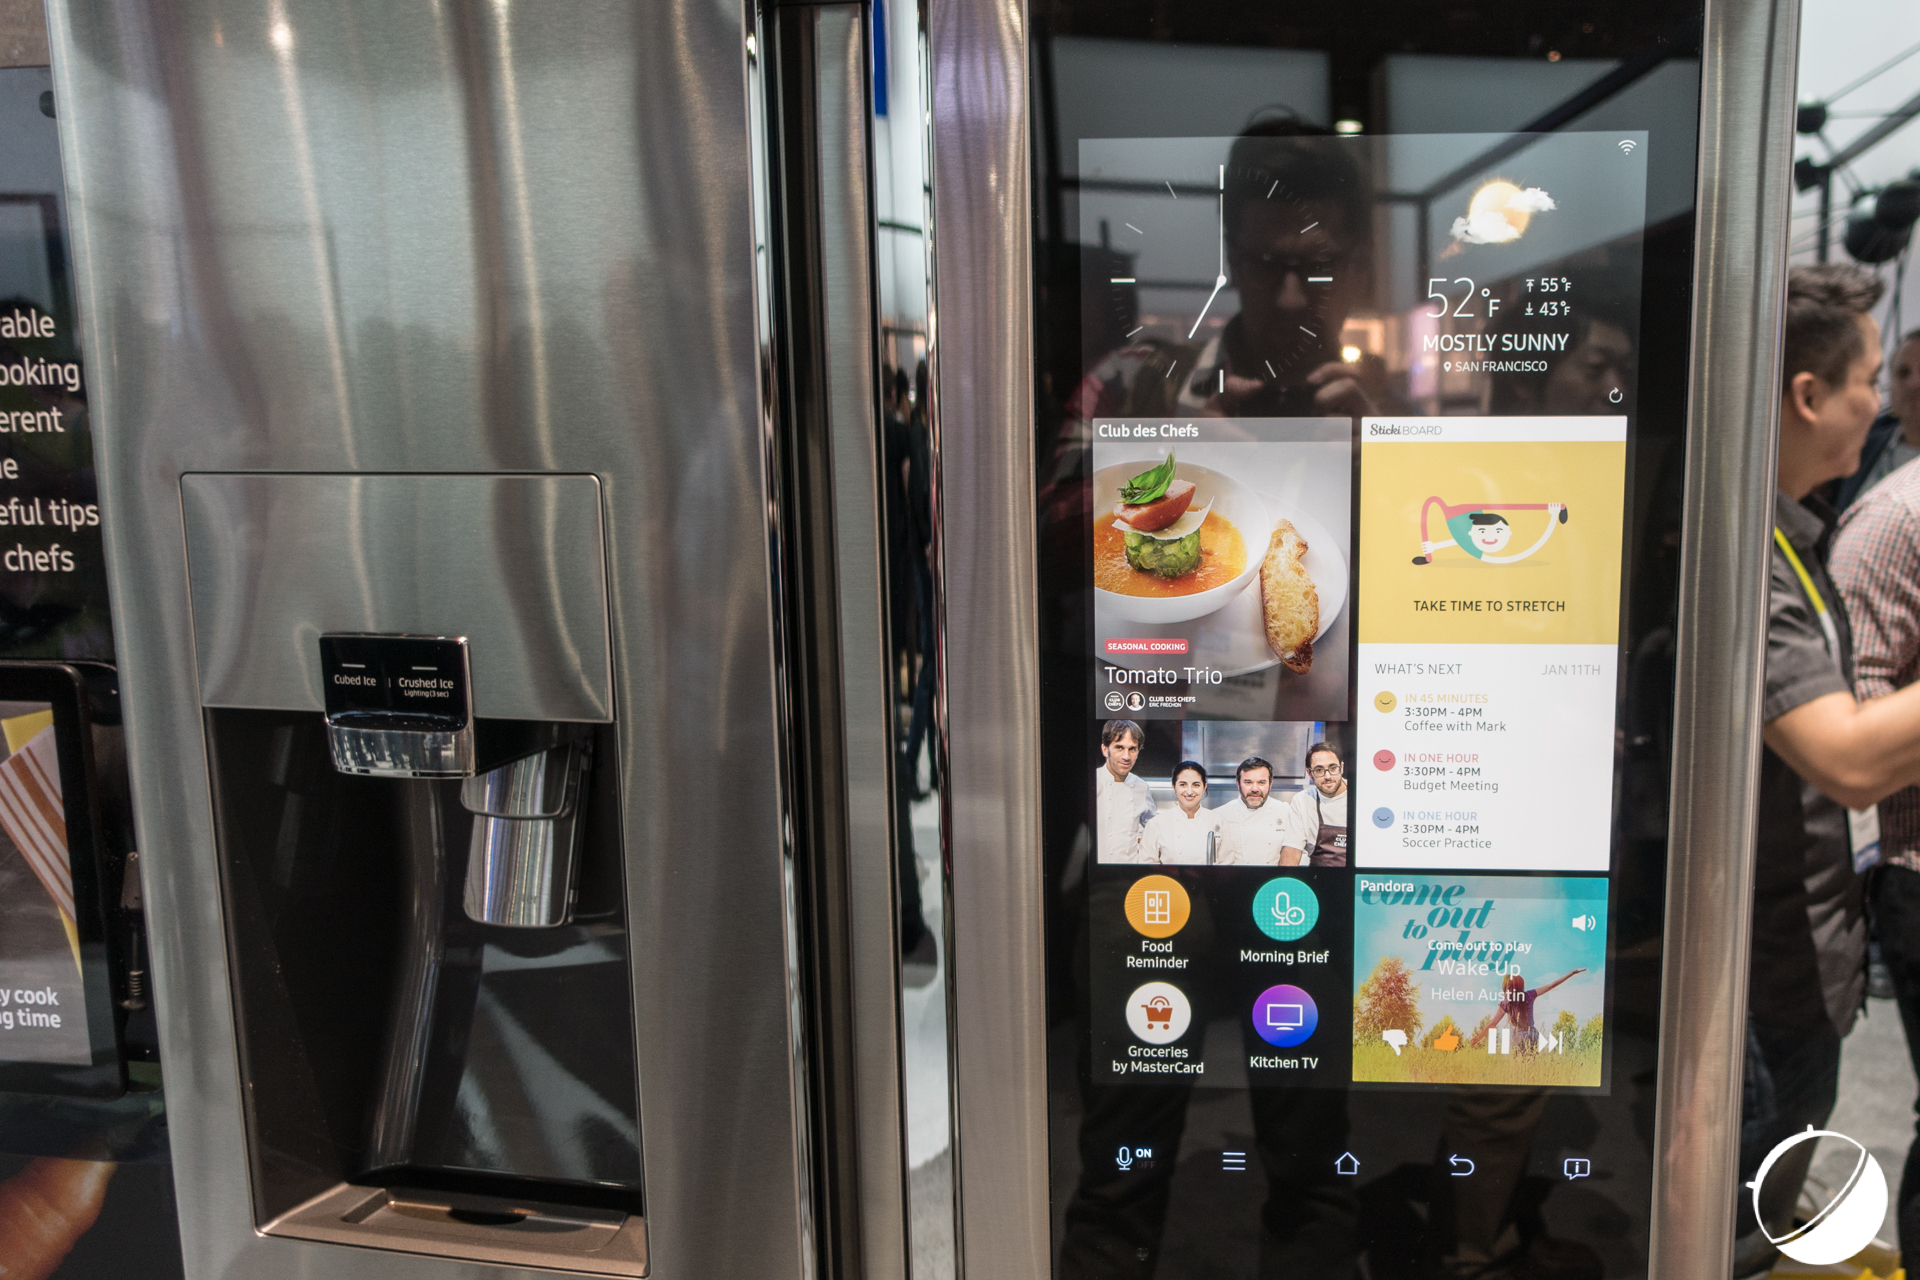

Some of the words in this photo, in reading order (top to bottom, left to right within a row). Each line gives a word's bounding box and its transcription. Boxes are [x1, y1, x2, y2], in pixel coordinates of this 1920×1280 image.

[0, 308, 55, 338] able
[1423, 334, 1497, 352] MOSTLY
[1501, 333, 1569, 351] SUNNY
[1455, 361, 1479, 372] SAN
[1482, 361, 1548, 372] FRANCISCO
[0, 356, 80, 391] ooking
[0, 406, 65, 433] erent
[1098, 424, 1130, 438] Club
[1133, 424, 1157, 438] des
[1160, 424, 1199, 437] Chefs
[0, 457, 19, 480] e
[0, 496, 45, 526] eful
[49, 498, 100, 532] tips
[4, 543, 75, 572] chefs
[1413, 600, 1447, 612] TAKE
[1450, 600, 1482, 612] TIME
[1486, 600, 1503, 612] TO
[1506, 600, 1565, 612] STRETCH
[1107, 643, 1148, 651] SEASONAL
[1150, 643, 1186, 651] COOKING
[1104, 666, 1177, 685] Tomato
[1183, 666, 1223, 685] Trio
[1428, 663, 1462, 675] NEXT
[1541, 664, 1568, 676] JAN
[1571, 664, 1601, 676] 11TH
[334, 674, 361, 686] Cubed
[363, 676, 377, 686] Ice
[398, 677, 437, 689] Crushed
[439, 679, 454, 689] Ice
[1405, 694, 1417, 703] IN
[1420, 694, 1433, 703] 45
[1437, 694, 1489, 704] MINUTES
[1404, 707, 1447, 717] 3:30PM
[1458, 707, 1482, 717] 4PM
[1404, 720, 1443, 731] Coffee
[1446, 720, 1472, 731] with
[1476, 721, 1506, 732] Mark
[1404, 753, 1416, 763] IN
[1419, 753, 1443, 763] ONE
[1446, 753, 1479, 763] HOUR
[1403, 766, 1446, 776] 3:30PM
[1456, 767, 1481, 777] 4PM
[1403, 780, 1446, 793] Budget
[1450, 780, 1499, 793] Meeting
[1403, 811, 1415, 820] IN
[1418, 811, 1442, 821] ONE
[1445, 811, 1478, 821] HOUR
[1402, 824, 1444, 834] 3:30PM
[1455, 824, 1479, 834] 4PM
[1402, 837, 1441, 848] Soccer
[1444, 837, 1492, 848] Practice
[1360, 880, 1414, 892] Pandora
[1427, 900, 1496, 929] out
[1402, 919, 1428, 939] to
[1141, 940, 1173, 953] Food
[1428, 940, 1463, 951] Come
[1465, 941, 1487, 951] out
[1489, 941, 1502, 951] to
[1505, 941, 1532, 954] play
[1126, 956, 1189, 969] Reminder
[1240, 950, 1294, 965] Morning
[1297, 950, 1330, 963] Brief
[1437, 959, 1489, 976] Wake
[1495, 960, 1521, 980] Up
[0, 988, 11, 1007] y
[14, 986, 59, 1006] cook
[1431, 987, 1474, 1001] Helen
[1478, 988, 1525, 1002] Austin
[0, 1011, 15, 1030] g
[17, 1008, 61, 1028] time
[1128, 1046, 1189, 1058] Groceries
[1112, 1060, 1128, 1074] by
[1131, 1061, 1204, 1074] MasterCard
[1250, 1056, 1299, 1069] Kitchen
[1302, 1057, 1319, 1069] TV
[1135, 1148, 1152, 1158] ON
[1136, 1161, 1156, 1169] OFF
